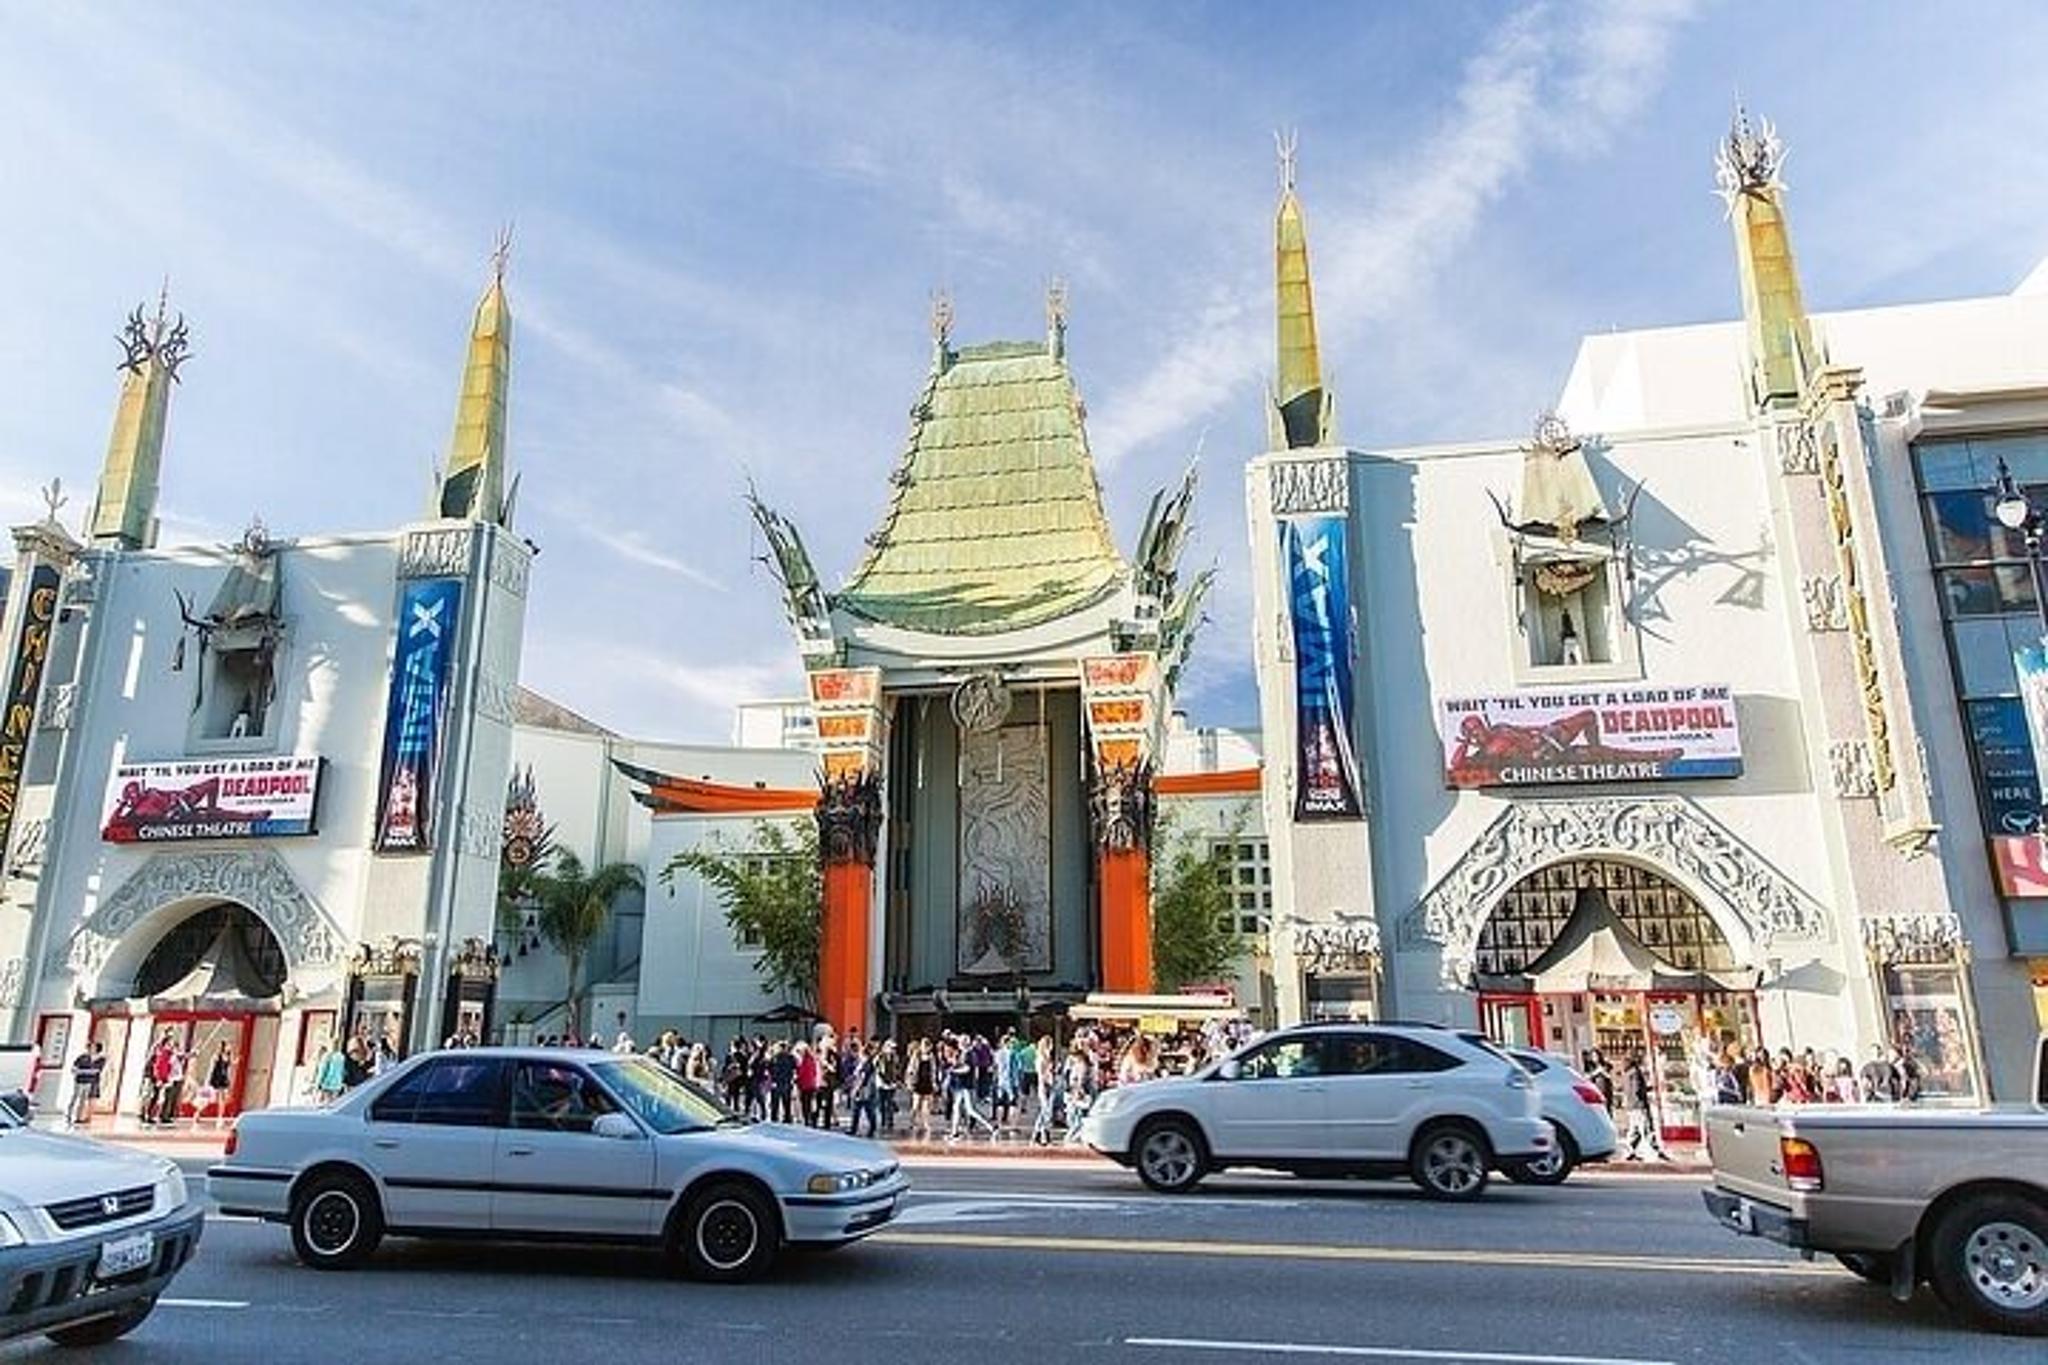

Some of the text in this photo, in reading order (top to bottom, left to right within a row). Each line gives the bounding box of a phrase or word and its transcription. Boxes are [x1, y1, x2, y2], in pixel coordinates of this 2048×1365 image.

[1446, 699, 1488, 712] WAIT
[1529, 696, 1565, 709] YOU
[1569, 693, 1600, 706] GET
[1606, 693, 1618, 705] A
[1623, 690, 1668, 704] LOAD
[1673, 688, 1697, 702] OF
[1702, 687, 1730, 700] ME
[1602, 706, 1734, 734] DEADPOOL
[1499, 764, 1577, 783] CHINESE
[1580, 761, 1663, 781] THEATRE
[222, 774, 312, 798] DEADPOOL
[139, 823, 194, 839] CHINESE
[195, 820, 251, 837] THEATRE
